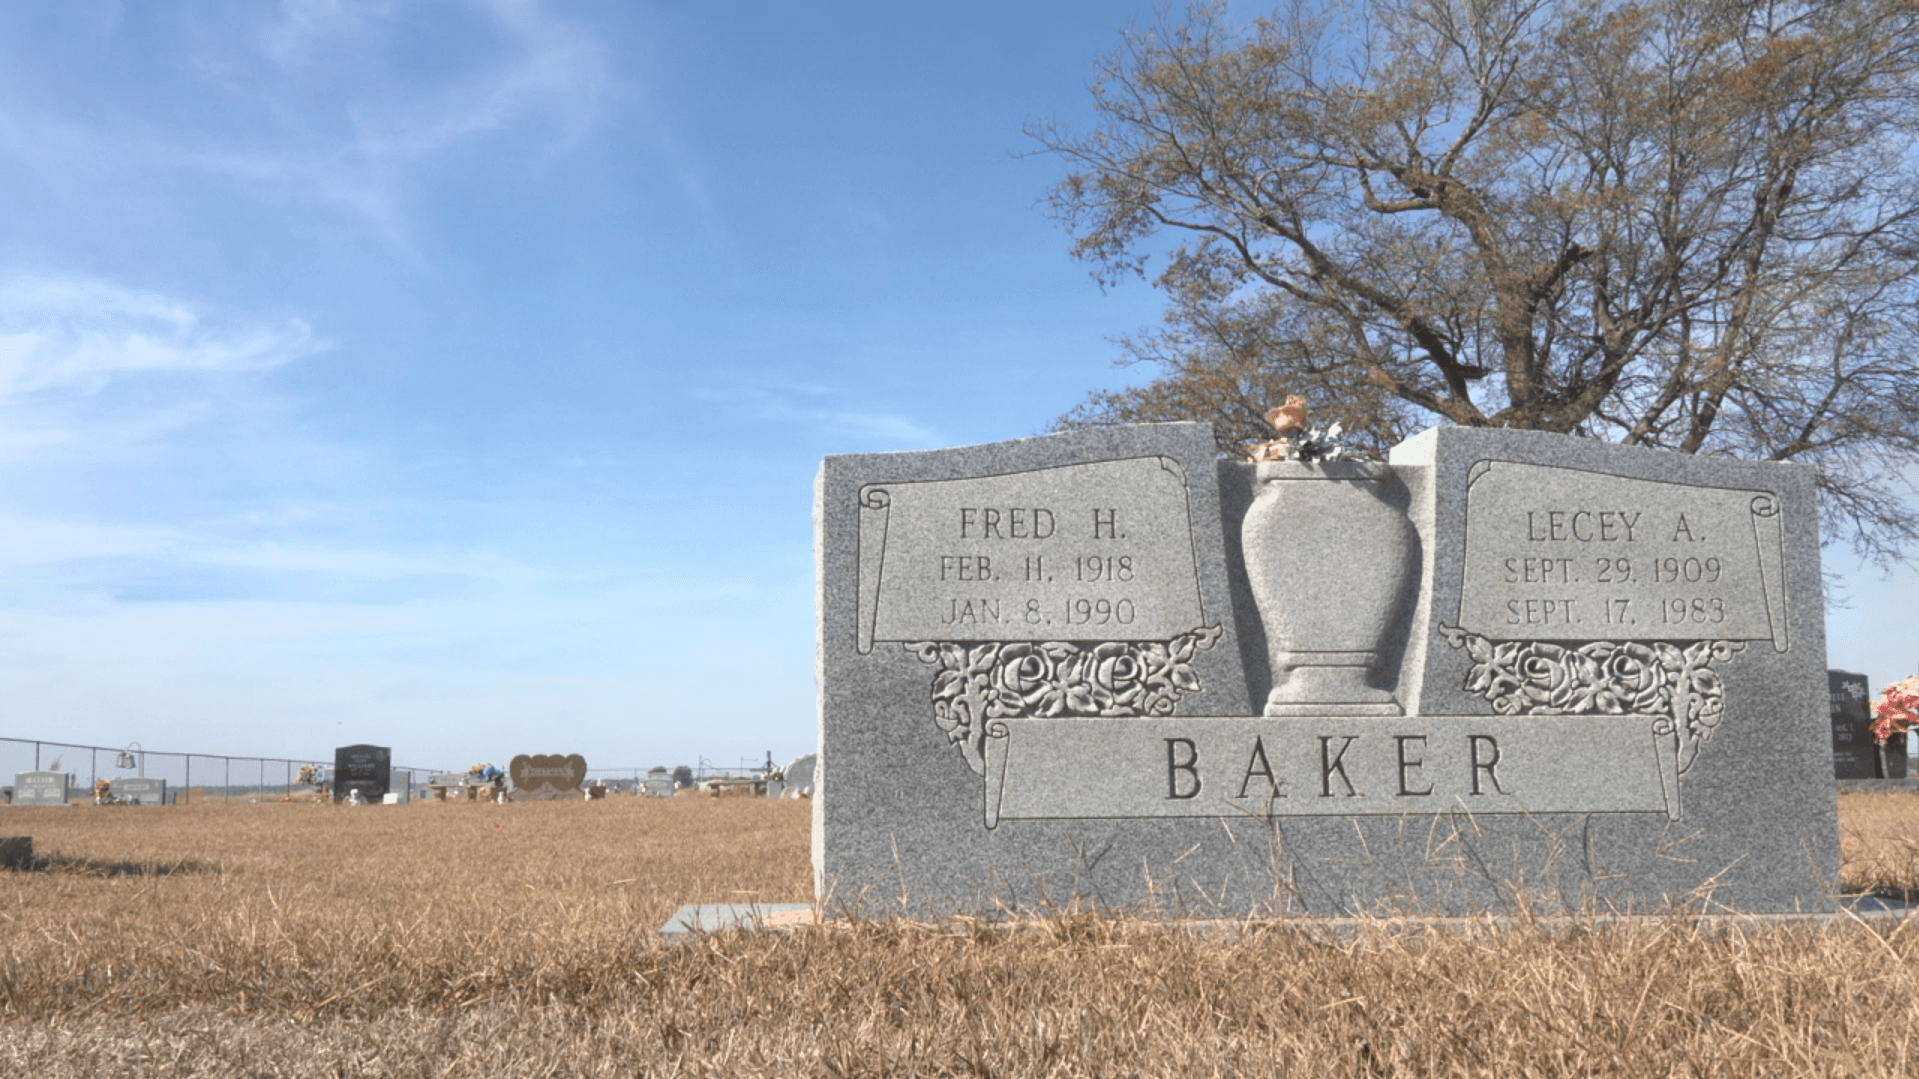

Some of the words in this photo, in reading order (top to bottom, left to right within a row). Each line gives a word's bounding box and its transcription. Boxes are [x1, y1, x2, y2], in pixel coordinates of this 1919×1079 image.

[960, 508, 1055, 539] FRED
[1093, 508, 1127, 539] H.
[1527, 511, 1641, 542] LECEY
[1672, 512, 1706, 542] A.
[940, 556, 1001, 582] FEB.
[1076, 556, 1135, 583] 1918
[1504, 558, 1580, 583] SEPT.
[1653, 557, 1722, 583] 1909
[941, 599, 1010, 625] JAN.
[1066, 599, 1136, 625] 1990
[1506, 600, 1582, 625] SEPT.
[1662, 599, 1725, 625] 1983
[1164, 734, 1512, 799] BAKER
